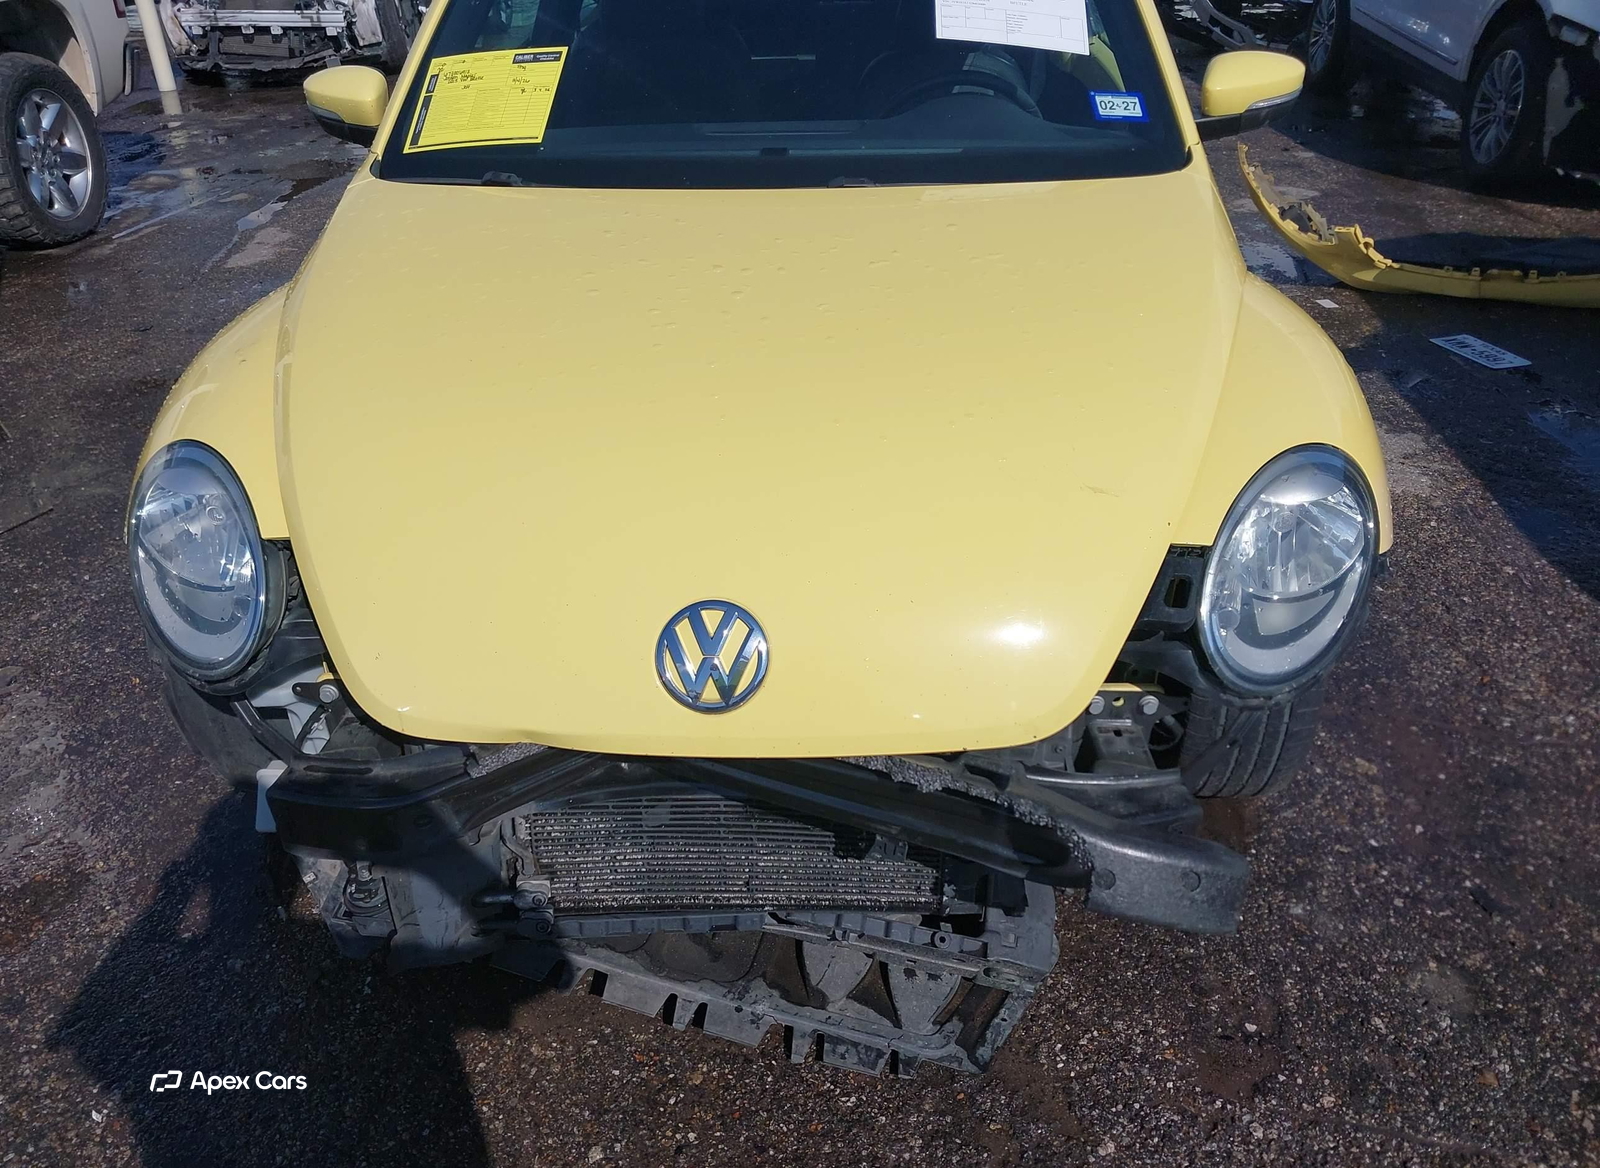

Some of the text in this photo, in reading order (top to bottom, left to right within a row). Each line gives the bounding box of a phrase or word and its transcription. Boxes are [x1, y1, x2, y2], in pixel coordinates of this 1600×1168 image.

[1099, 100, 1138, 111] 02 27
[655, 599, 769, 712] VW
